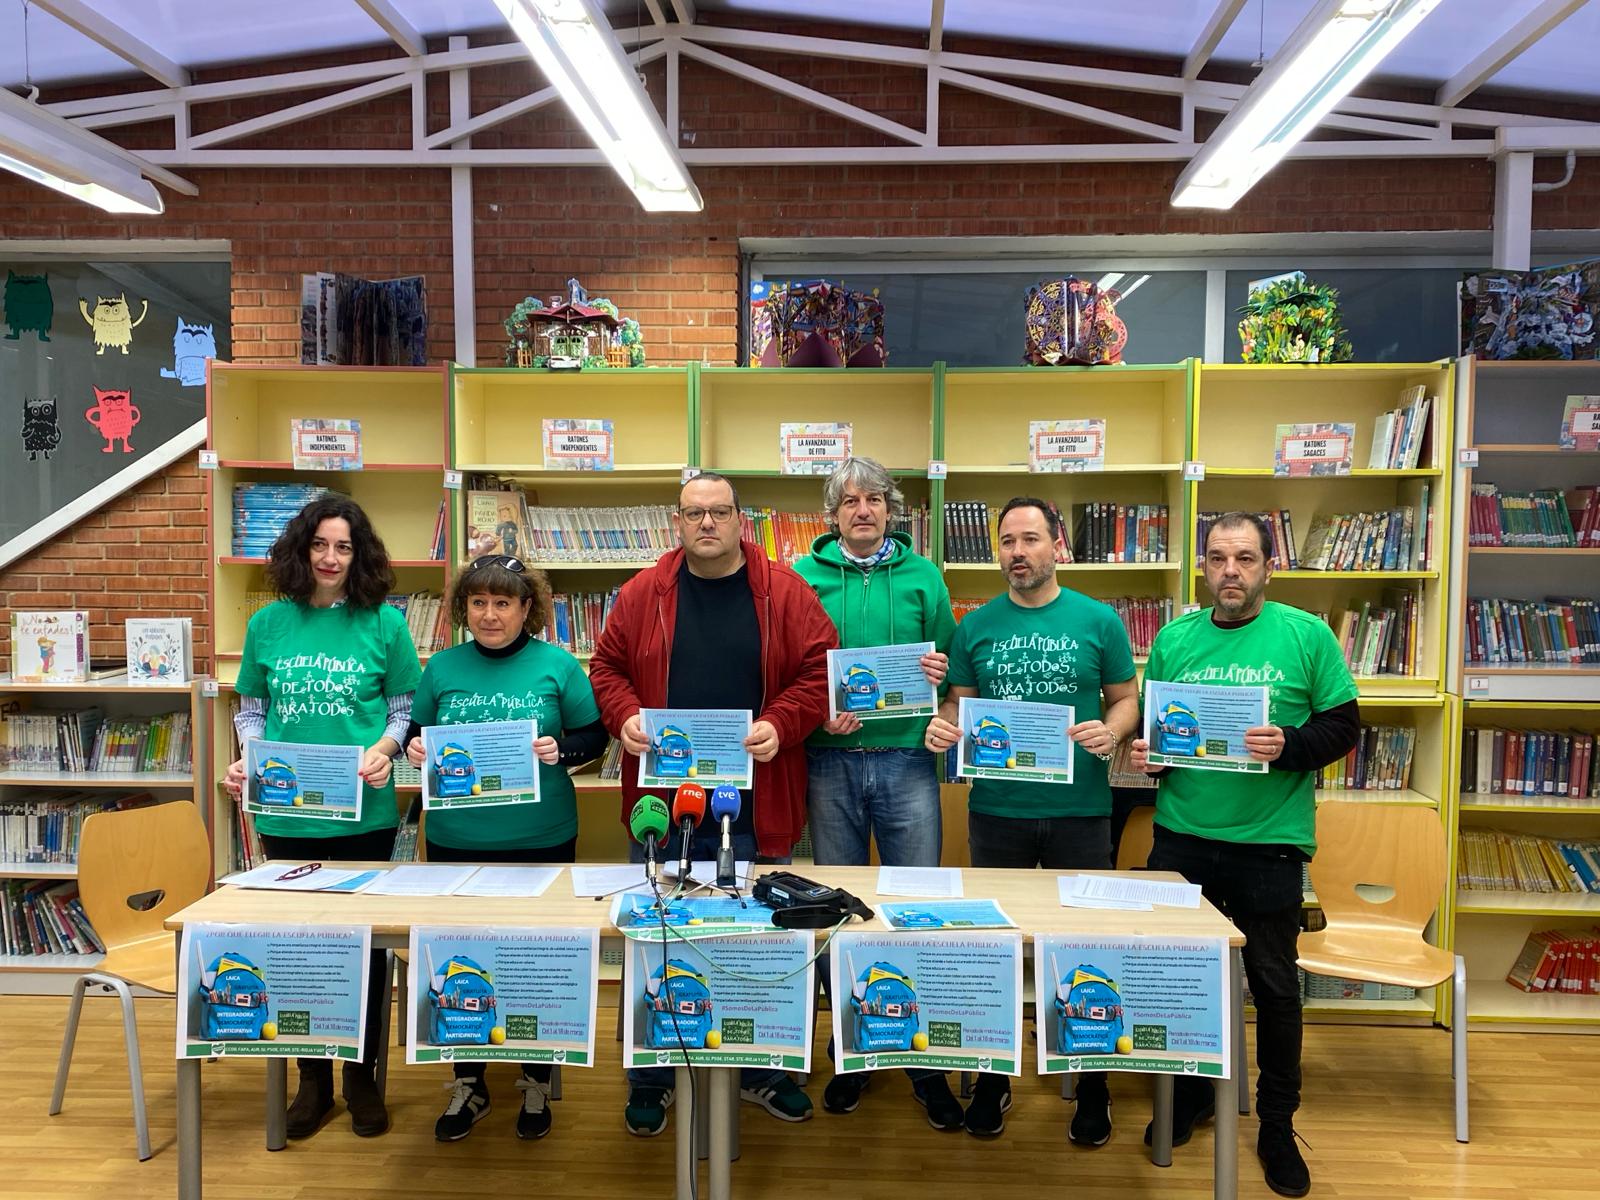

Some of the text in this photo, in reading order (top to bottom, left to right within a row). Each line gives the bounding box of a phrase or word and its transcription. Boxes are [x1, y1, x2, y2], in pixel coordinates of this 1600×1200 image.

[805, 438, 836, 447] AVANZADILLA
[1047, 435, 1087, 444] LA AVANZADILLA
[1303, 440, 1326, 448] RATONES
[309, 443, 346, 452] INDEPENDIENTES
[560, 444, 598, 452] INDEPENDIENTES
[1058, 444, 1076, 453] DE FITO
[1303, 449, 1326, 457] SAGACES
[992, 634, 1036, 652] ESCUELA
[276, 654, 321, 671] ESCUELA
[998, 661, 1070, 675] DE TOD@S
[1184, 664, 1233, 682] ESCUELA
[282, 681, 300, 695] DE
[993, 681, 1024, 696] PARA
[450, 693, 496, 708] ESCUELA
[277, 701, 307, 716] PARA
[682, 788, 703, 799] rne
[717, 790, 736, 800] tve
